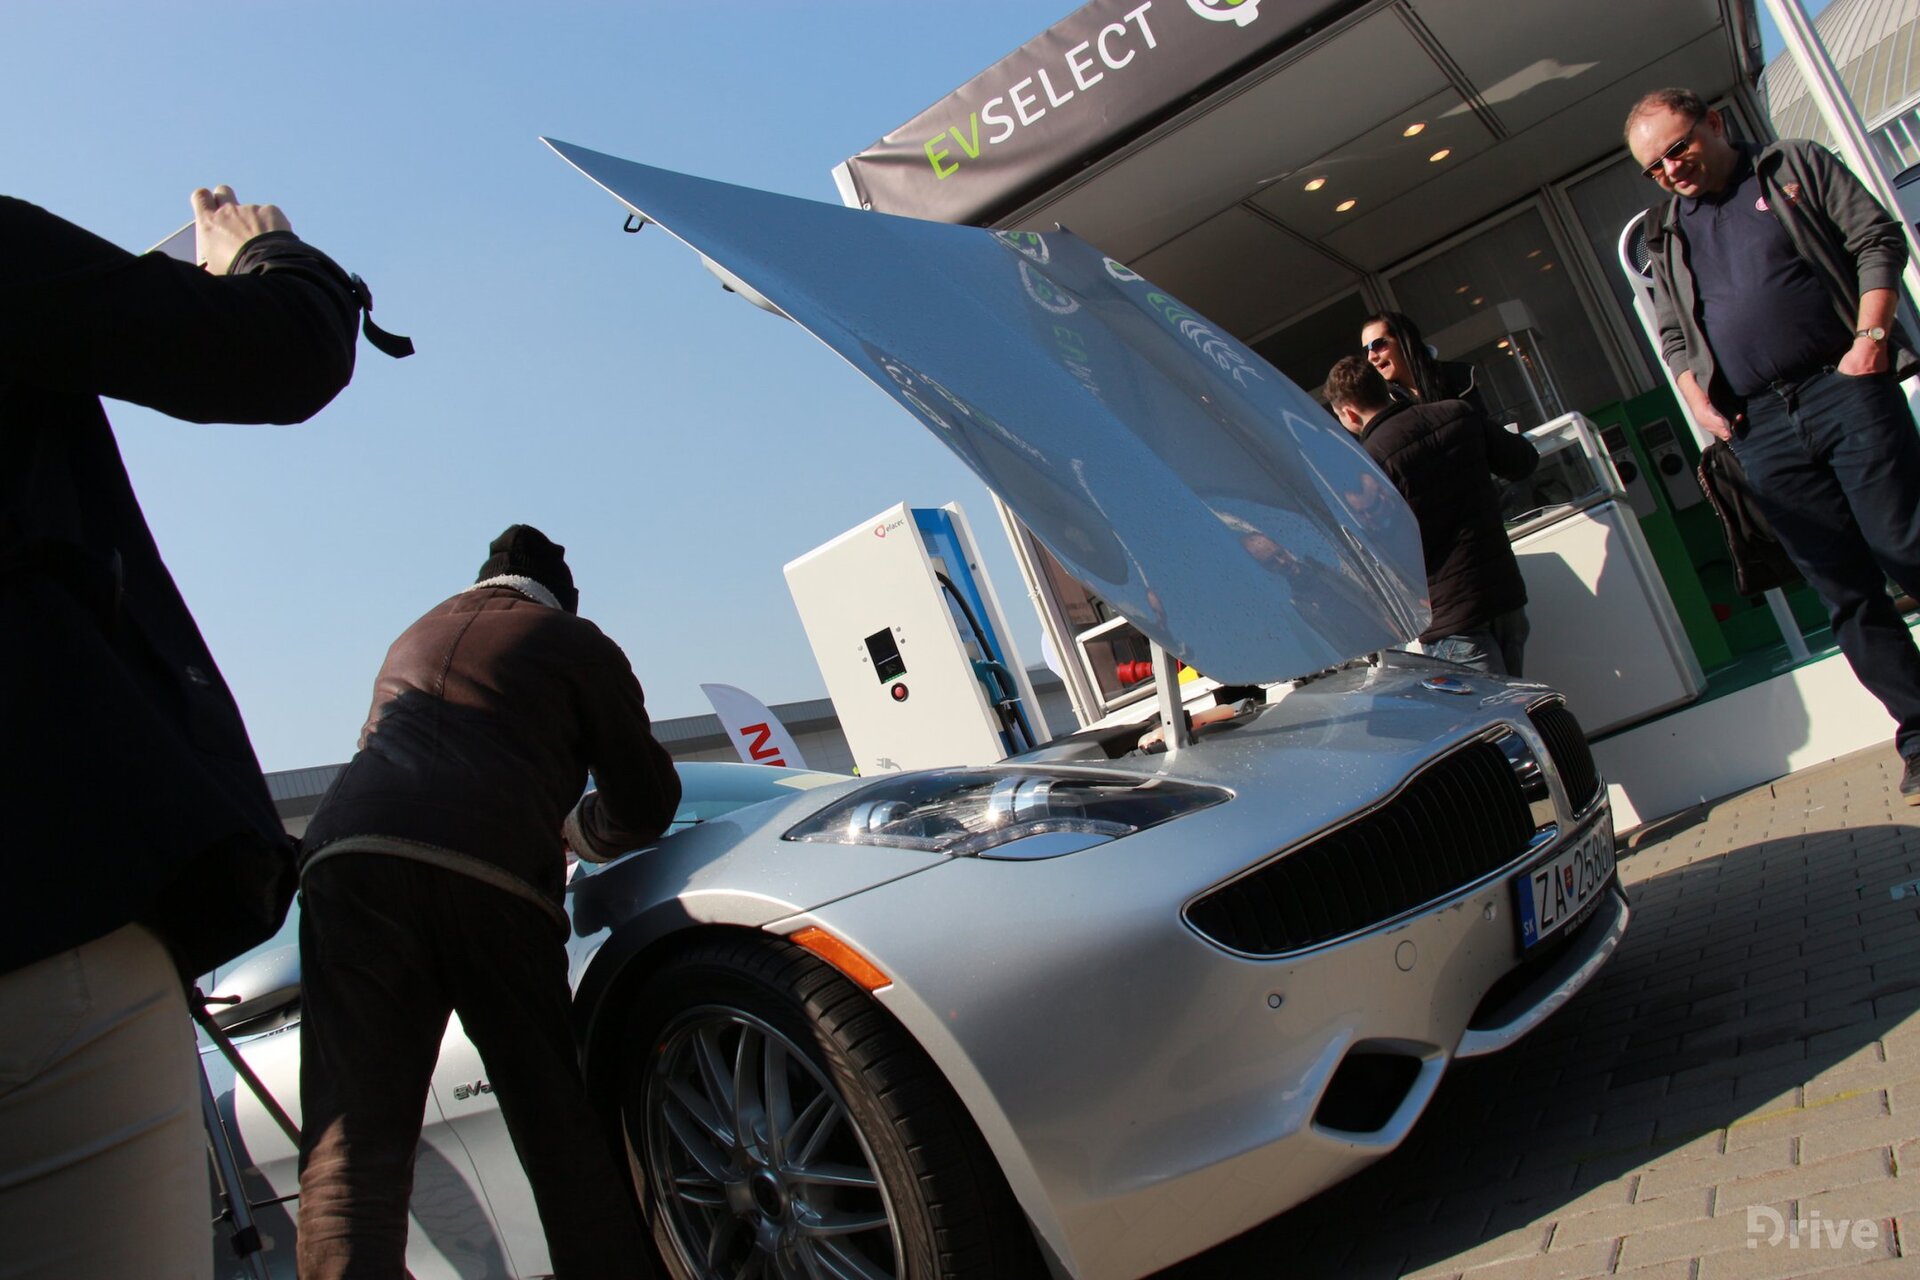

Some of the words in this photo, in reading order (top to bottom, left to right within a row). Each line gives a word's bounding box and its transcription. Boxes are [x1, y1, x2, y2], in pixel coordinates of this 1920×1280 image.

[923, 1, 1158, 181] EVSELECT
[1523, 920, 1535, 936] SK
[1535, 865, 1568, 931] ZA
